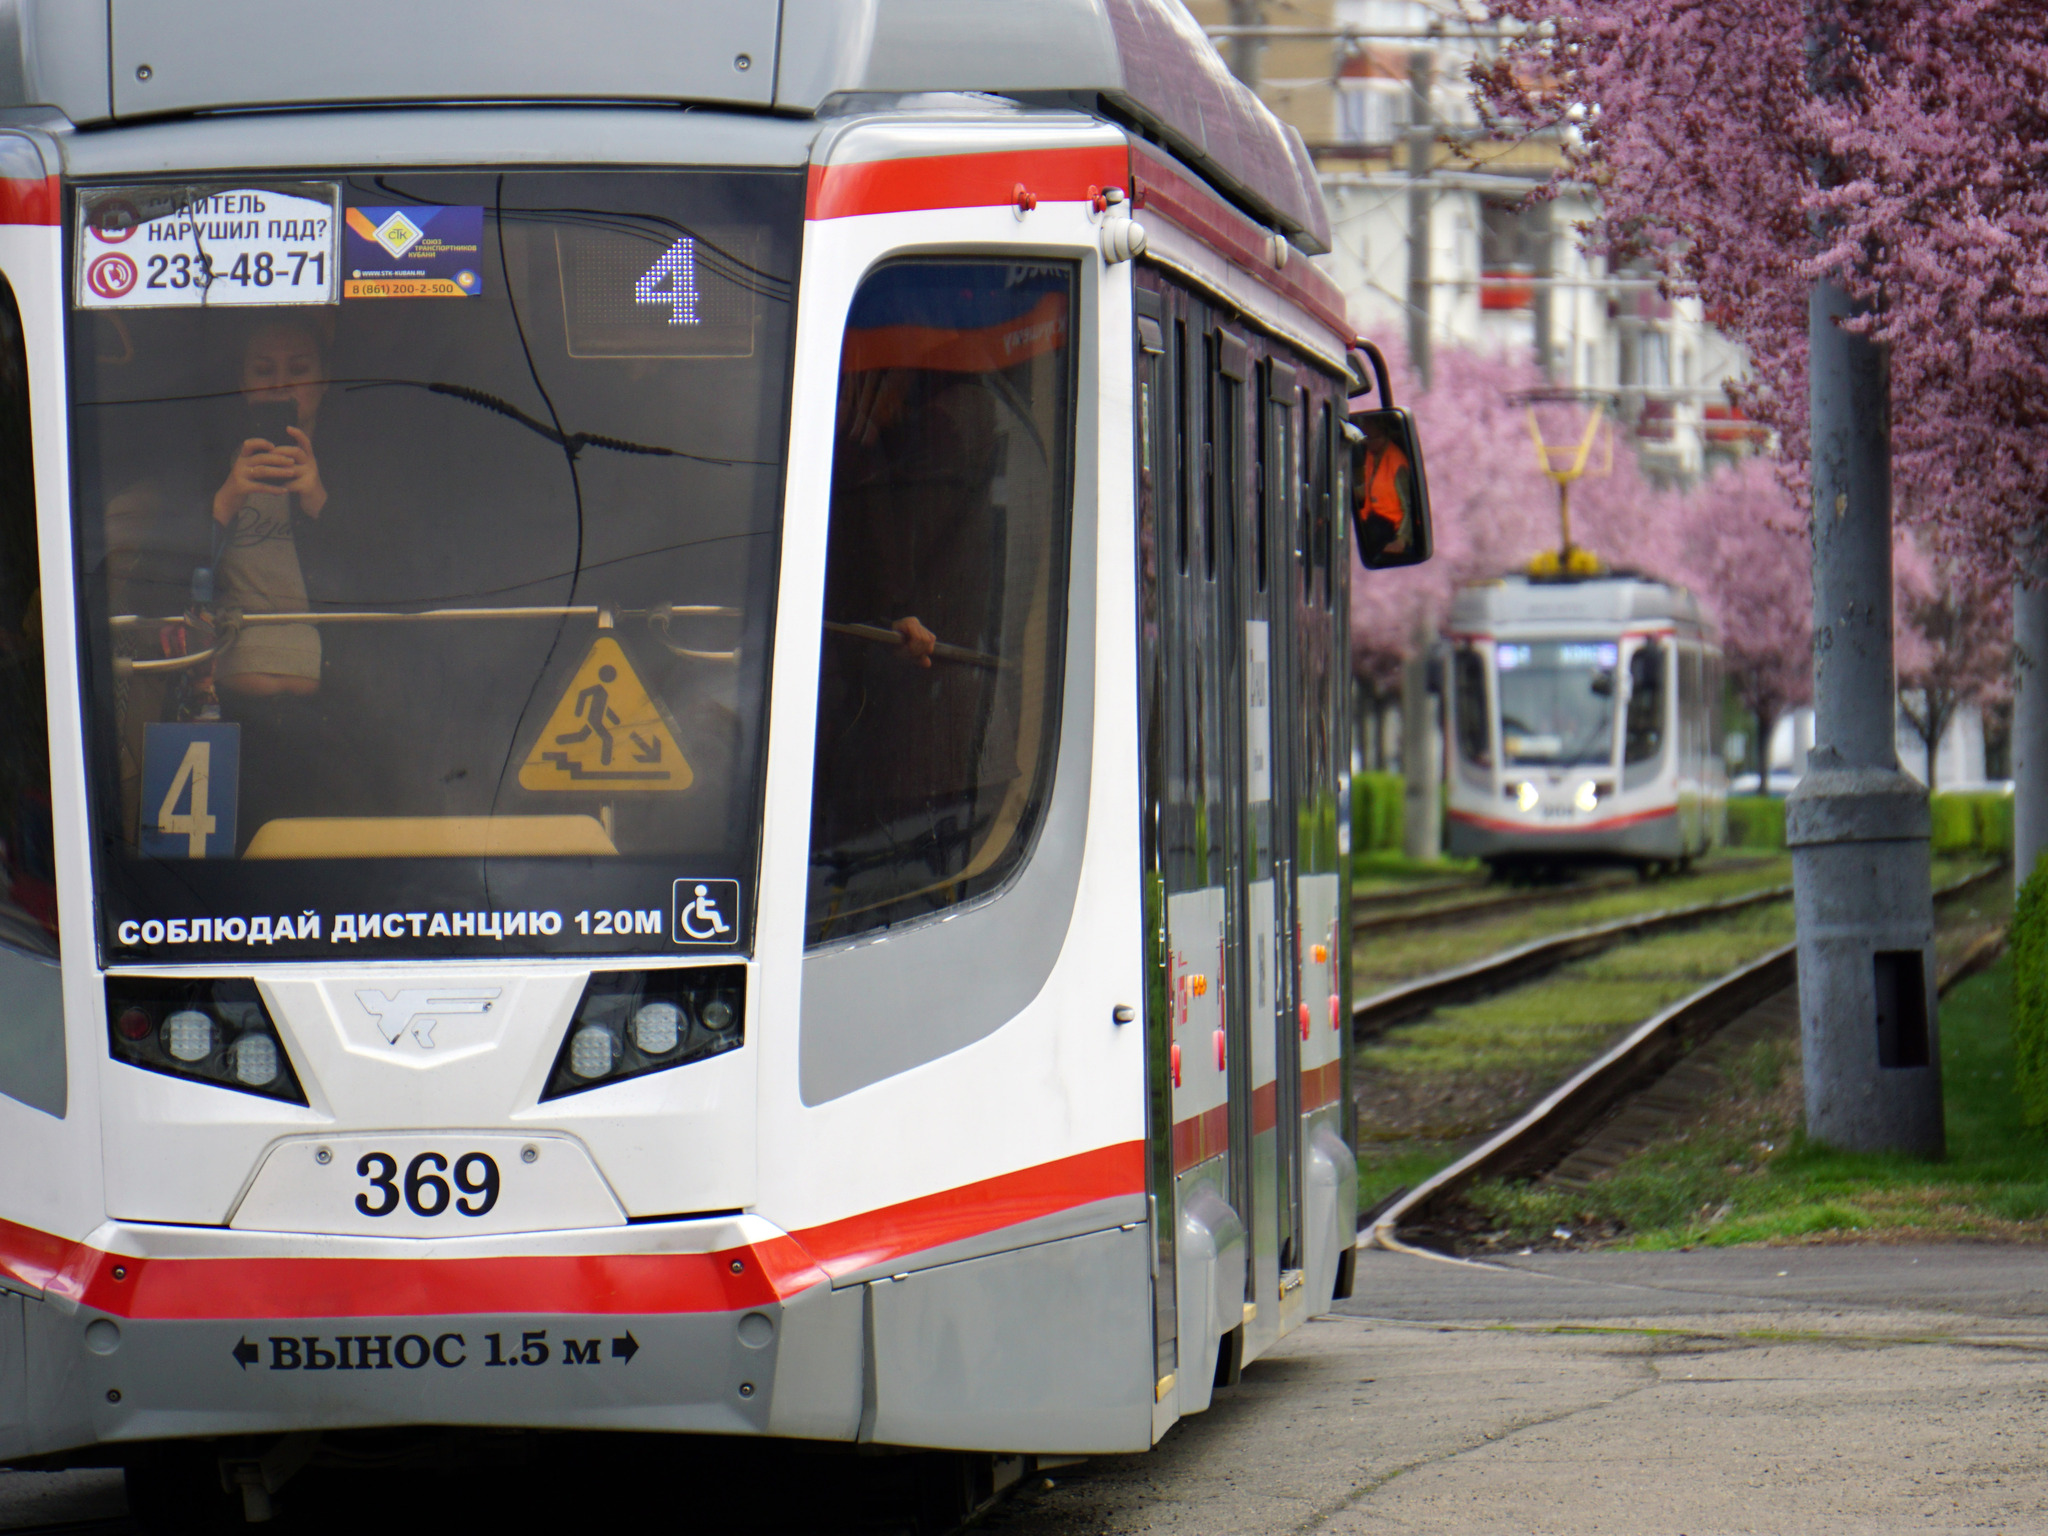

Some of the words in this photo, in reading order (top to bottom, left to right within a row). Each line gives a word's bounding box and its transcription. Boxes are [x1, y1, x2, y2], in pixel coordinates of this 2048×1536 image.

[152, 195, 266, 219] ДИТЕЛЬ
[149, 221, 259, 241] НАРУШИЛ
[268, 219, 328, 241] ПДД?
[146, 251, 326, 289] 233-48-71
[635, 238, 701, 325] 4
[352, 285, 360, 294] 8
[362, 284, 390, 295] (861)
[392, 284, 454, 294] 200-2-500
[158, 741, 216, 858] 4
[118, 910, 320, 945] СОБЛЮДАЙ
[331, 911, 562, 943] ДИСТАНЦИЮ
[574, 910, 662, 935] 120М
[355, 1152, 500, 1217] 369
[269, 1333, 467, 1370] ВЫНОС
[484, 1330, 549, 1367] 1.5
